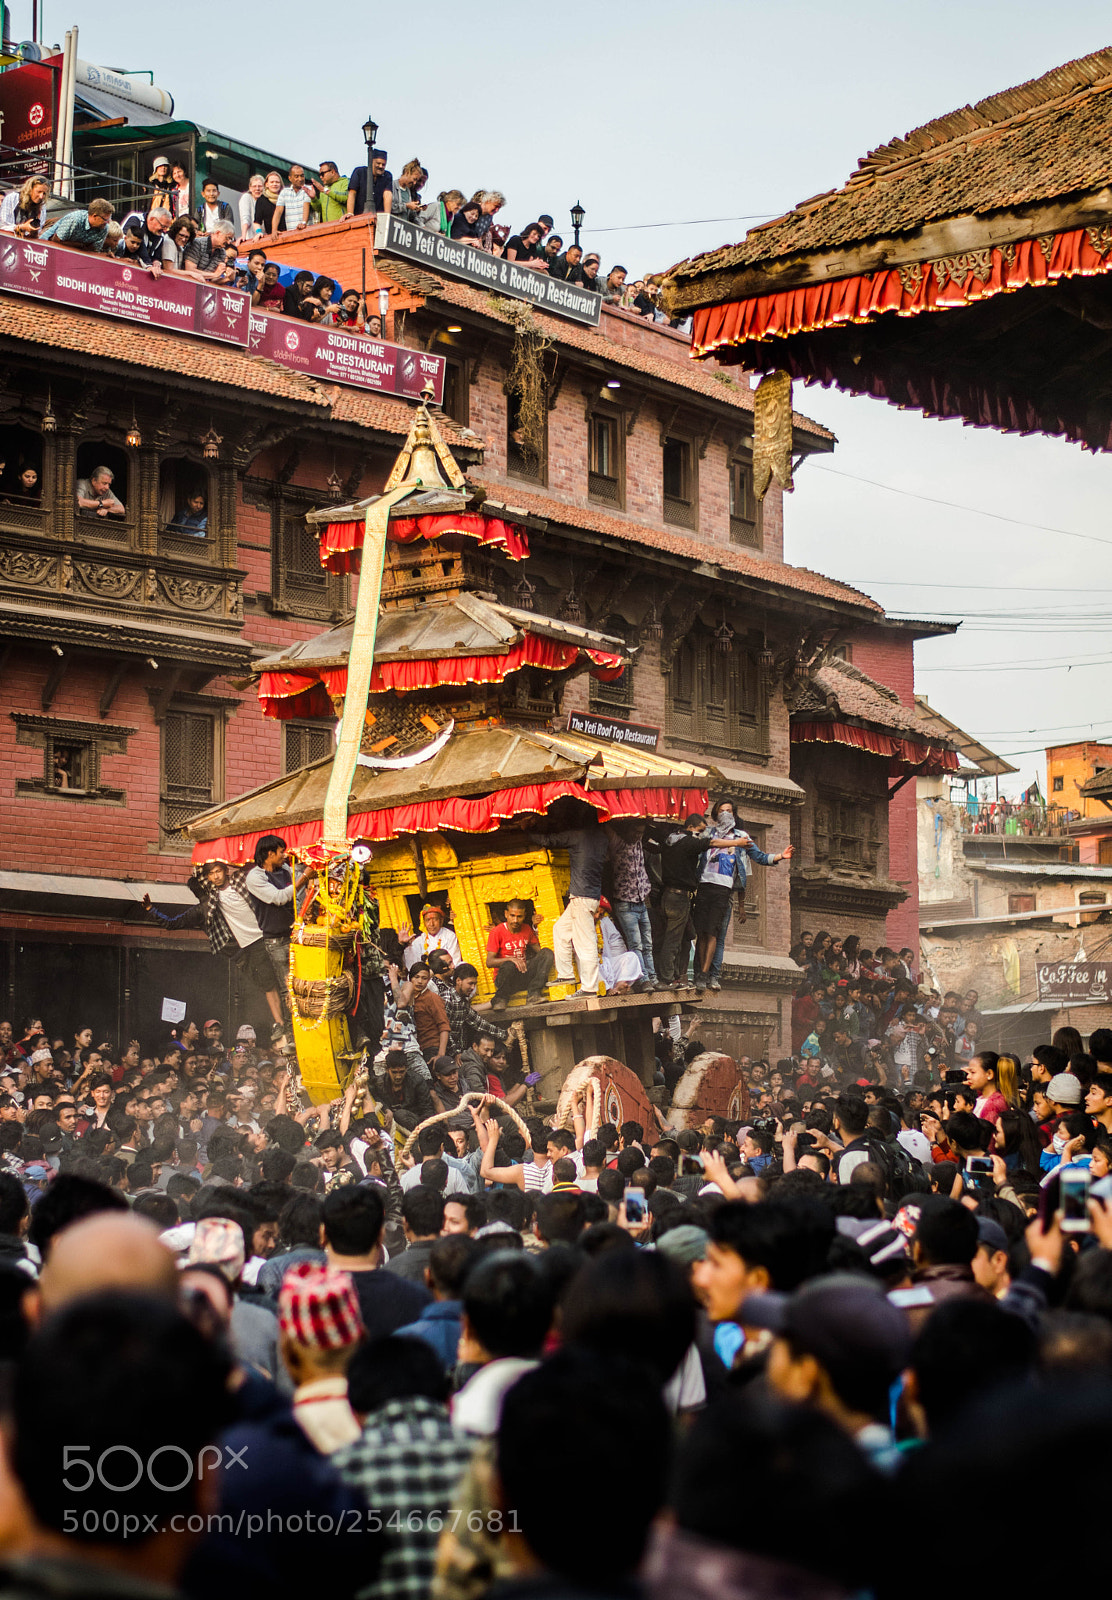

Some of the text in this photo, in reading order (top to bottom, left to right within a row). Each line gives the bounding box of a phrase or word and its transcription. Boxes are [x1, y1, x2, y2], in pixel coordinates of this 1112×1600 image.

[392, 220, 596, 316] The Yeti Guest House & Rooftop Restaurant
[56, 276, 193, 316] SIDDHI HOME AND RESTAURANT
[328, 334, 385, 358] SIDDHI HOME
[316, 347, 395, 376] AND RESTAURANT
[572, 718, 656, 746] The Yeti Roof Top Restaurant
